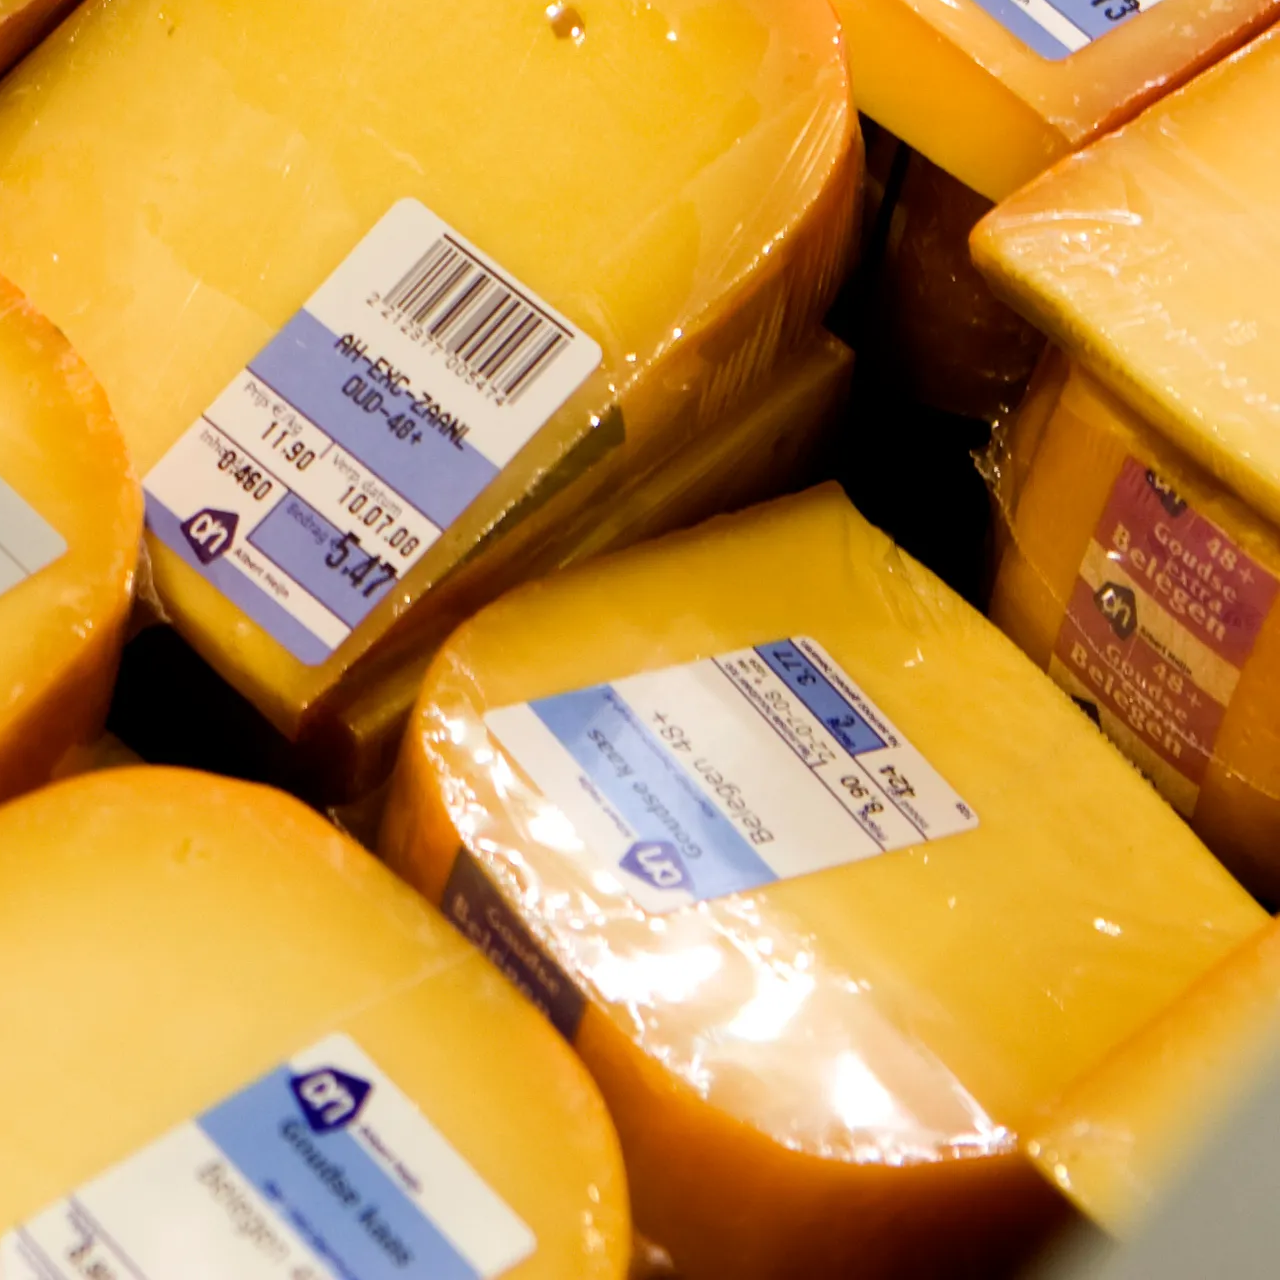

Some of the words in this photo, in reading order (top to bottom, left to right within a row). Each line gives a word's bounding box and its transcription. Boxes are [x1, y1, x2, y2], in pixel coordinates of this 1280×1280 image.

[332, 329, 476, 451] AH-EXC-ZAANL
[340, 373, 427, 448] OUD-48+
[258, 420, 317, 473] 11.90
[335, 484, 421, 559] 10.07.08
[322, 531, 398, 603] 5.47
[1112, 523, 1227, 642] Belegen
[1153, 521, 1238, 604] Goudse
[1166, 561, 1223, 614] extra
[1205, 537, 1255, 586] 48+
[1070, 640, 1182, 759] Belegen
[1106, 642, 1189, 723] Goudse
[1153, 663, 1203, 708] 48+
[580, 729, 636, 776] kaas
[643, 709, 699, 753] 48+
[626, 782, 706, 858] Goudse
[686, 757, 782, 844] Belegen
[187, 1162, 300, 1262] Belegen
[271, 1118, 369, 1207] Goudse
[352, 1206, 423, 1268] kaas
